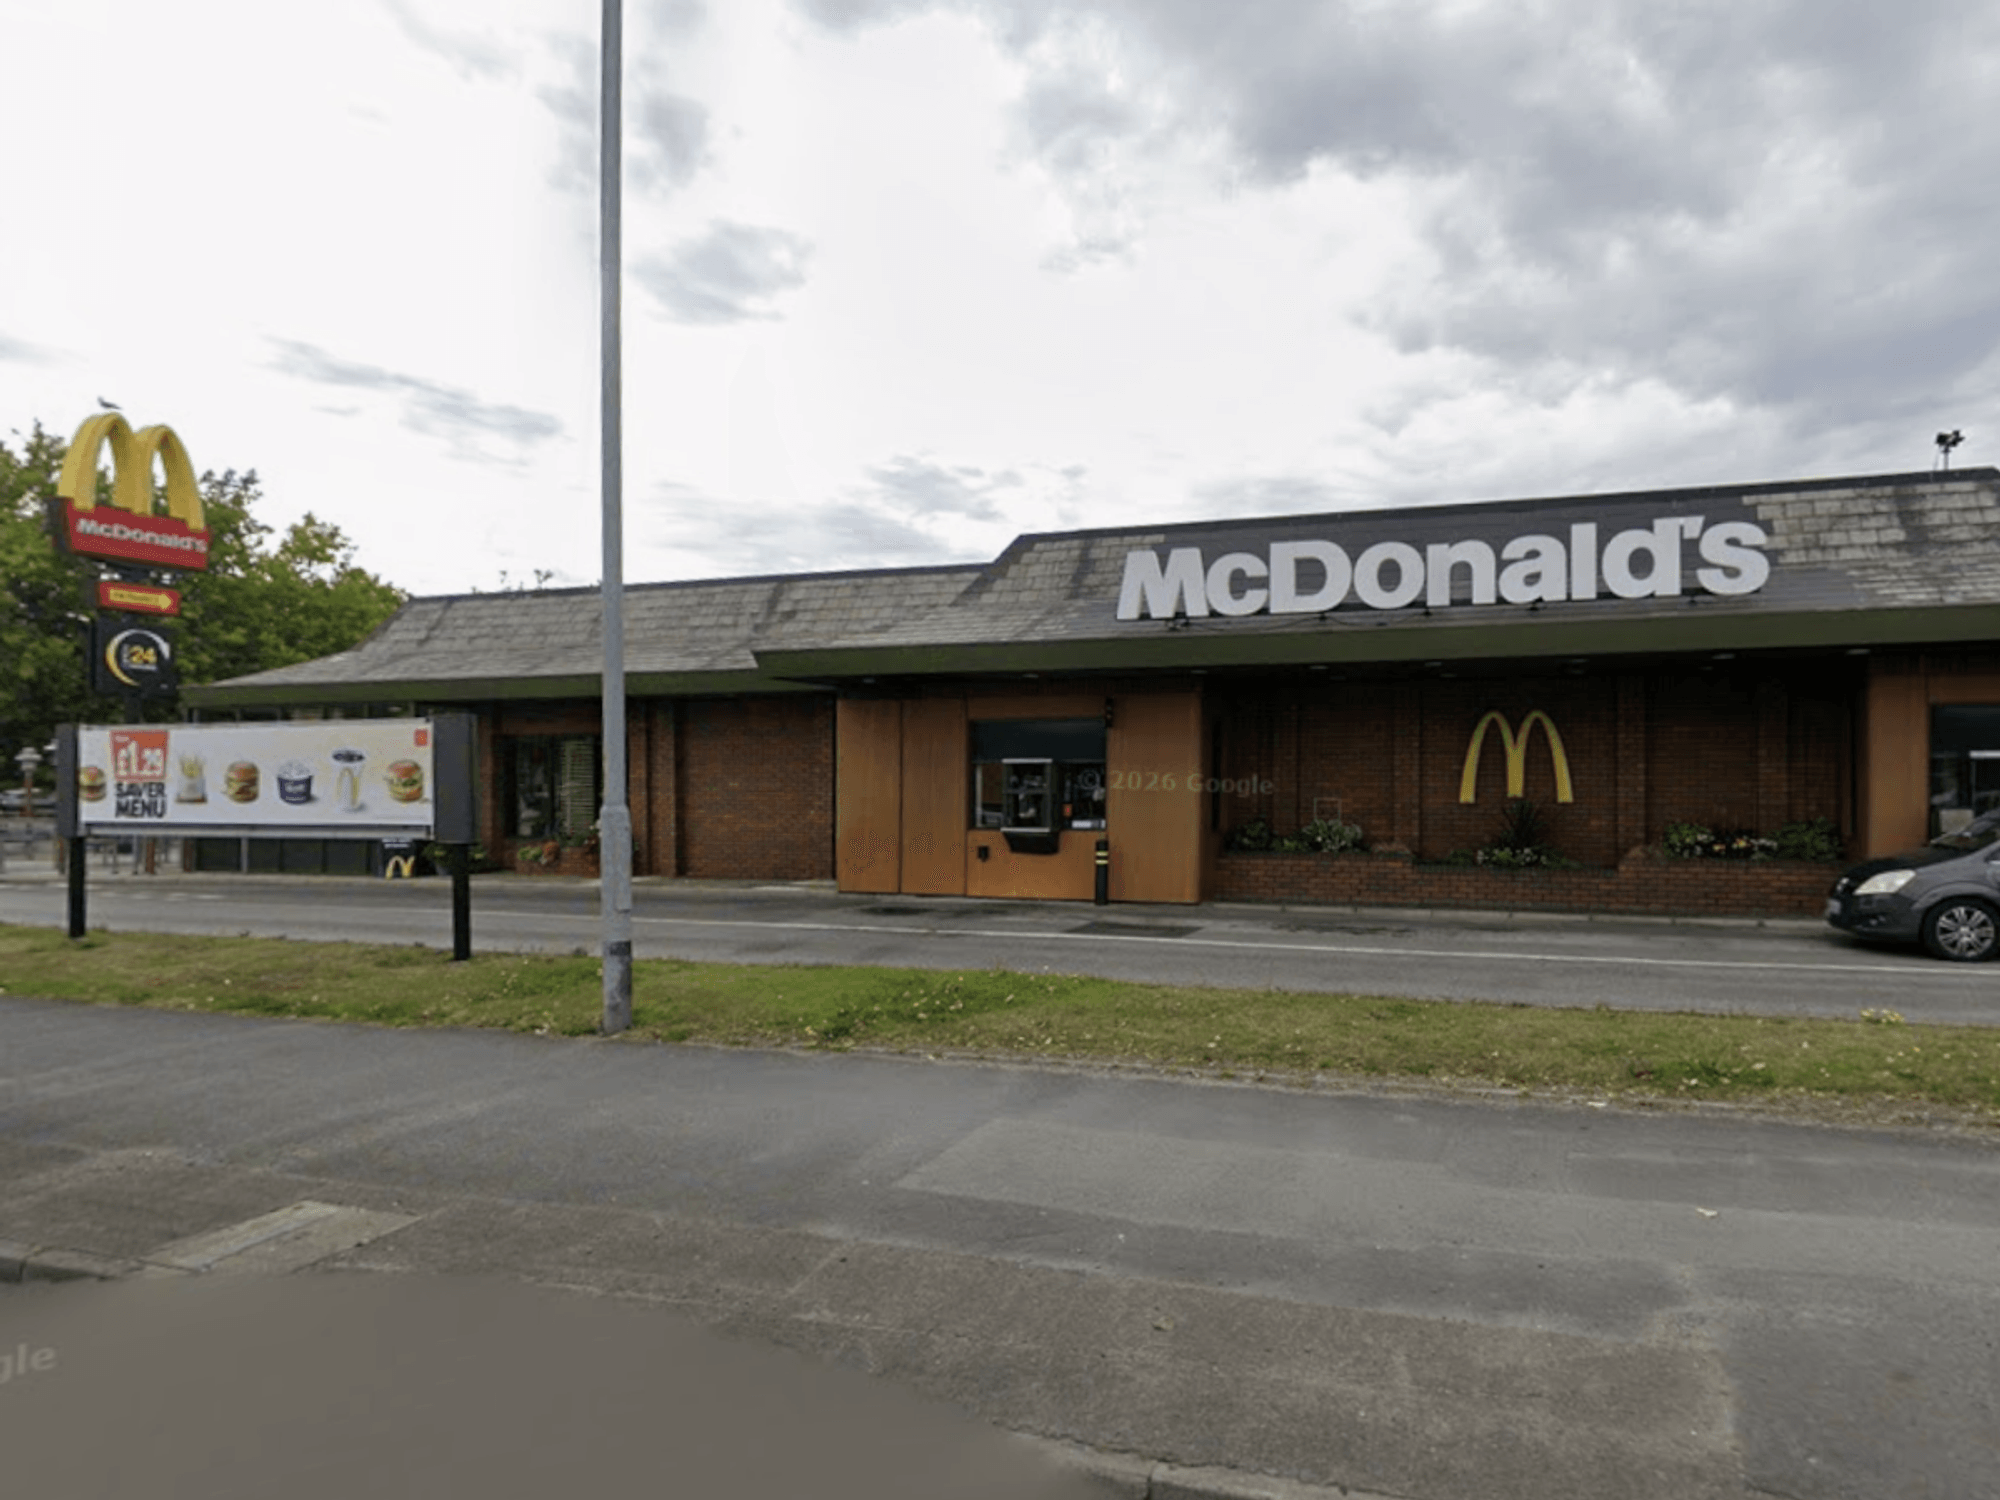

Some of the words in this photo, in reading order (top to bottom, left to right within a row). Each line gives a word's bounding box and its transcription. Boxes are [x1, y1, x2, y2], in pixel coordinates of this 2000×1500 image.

[75, 518, 208, 553] McDonald's
[1117, 516, 1770, 620] McDonald's
[115, 782, 165, 798] SAVER
[115, 798, 167, 818] MENU
